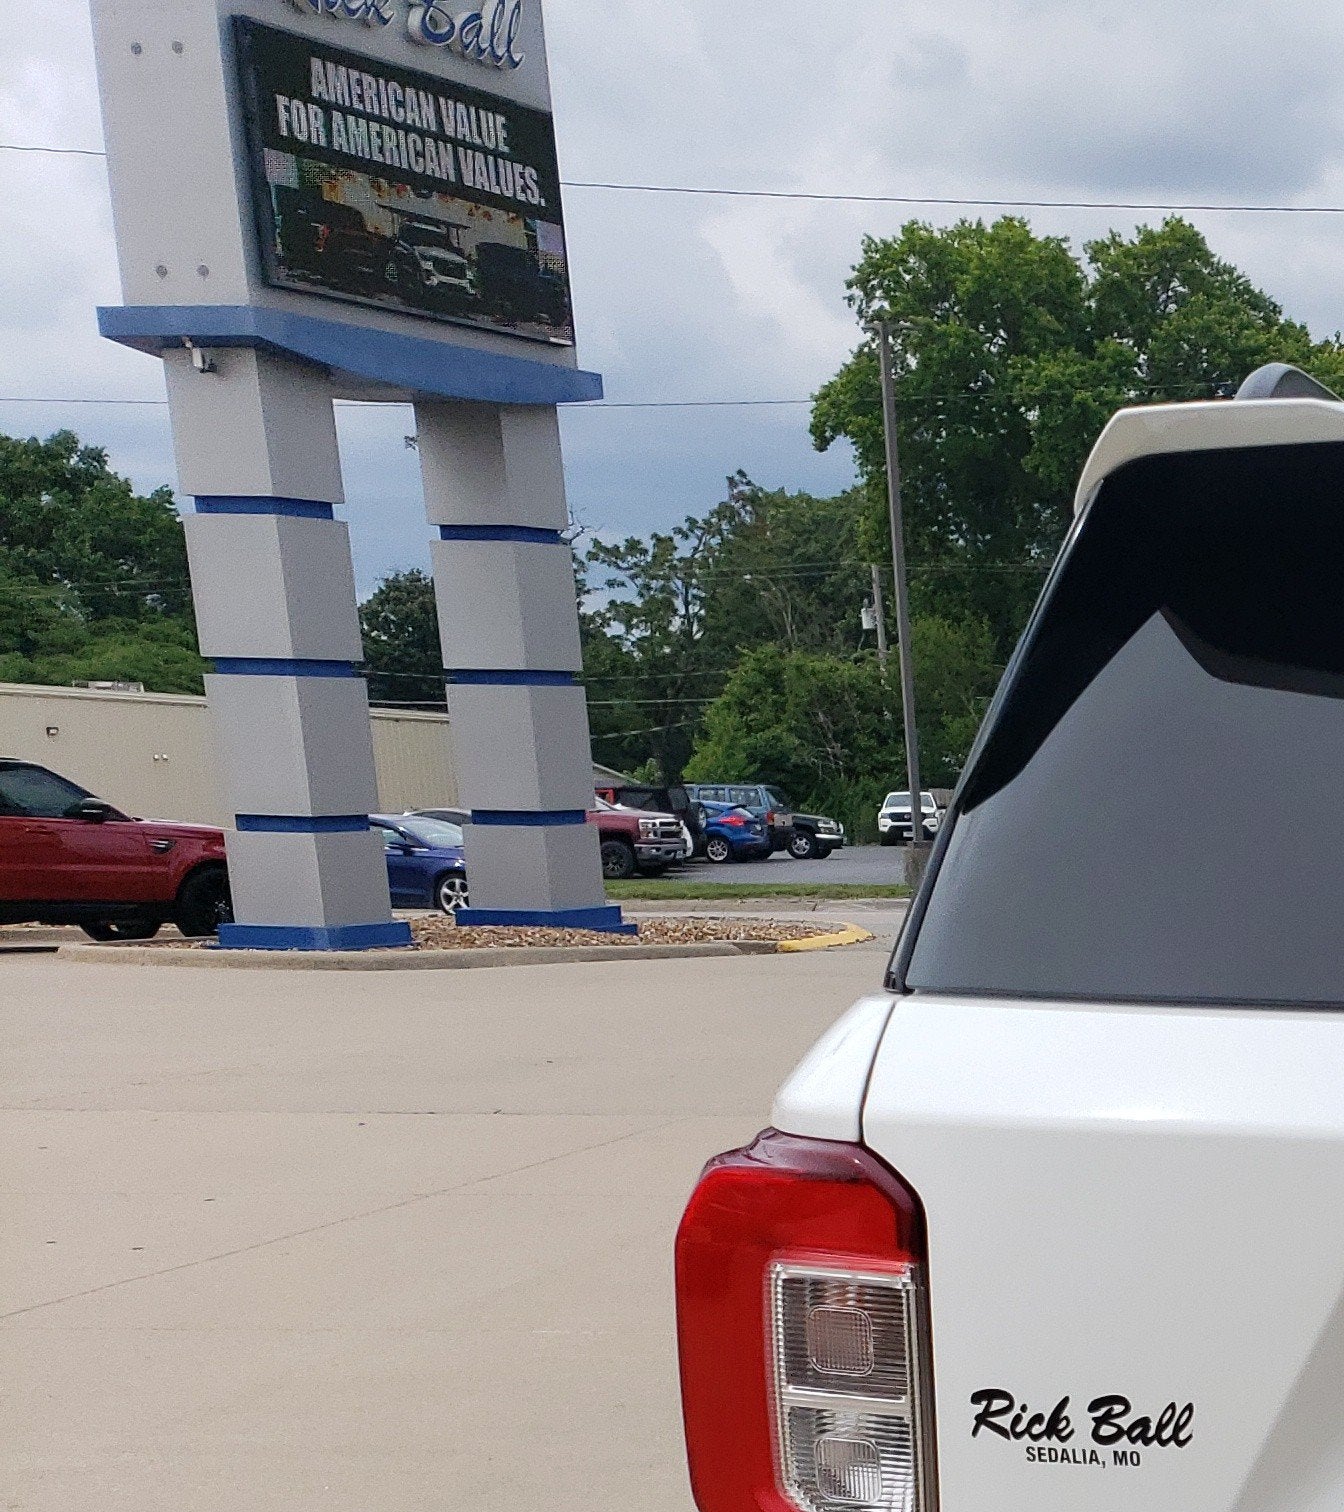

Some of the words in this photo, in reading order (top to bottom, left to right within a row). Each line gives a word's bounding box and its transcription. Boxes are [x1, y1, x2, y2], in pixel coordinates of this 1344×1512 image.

[408, 0, 525, 70] Ball
[310, 56, 437, 131] AMERICAN
[438, 96, 510, 152] VALUE
[275, 94, 327, 147] FOR
[331, 110, 455, 182] AMERICAN
[458, 146, 546, 206] VALUES.
[970, 1388, 1075, 1443] Rick
[1087, 1394, 1195, 1449] Ball
[1026, 1446, 1106, 1468] SEDALIA,
[1113, 1449, 1141, 1467] MO
